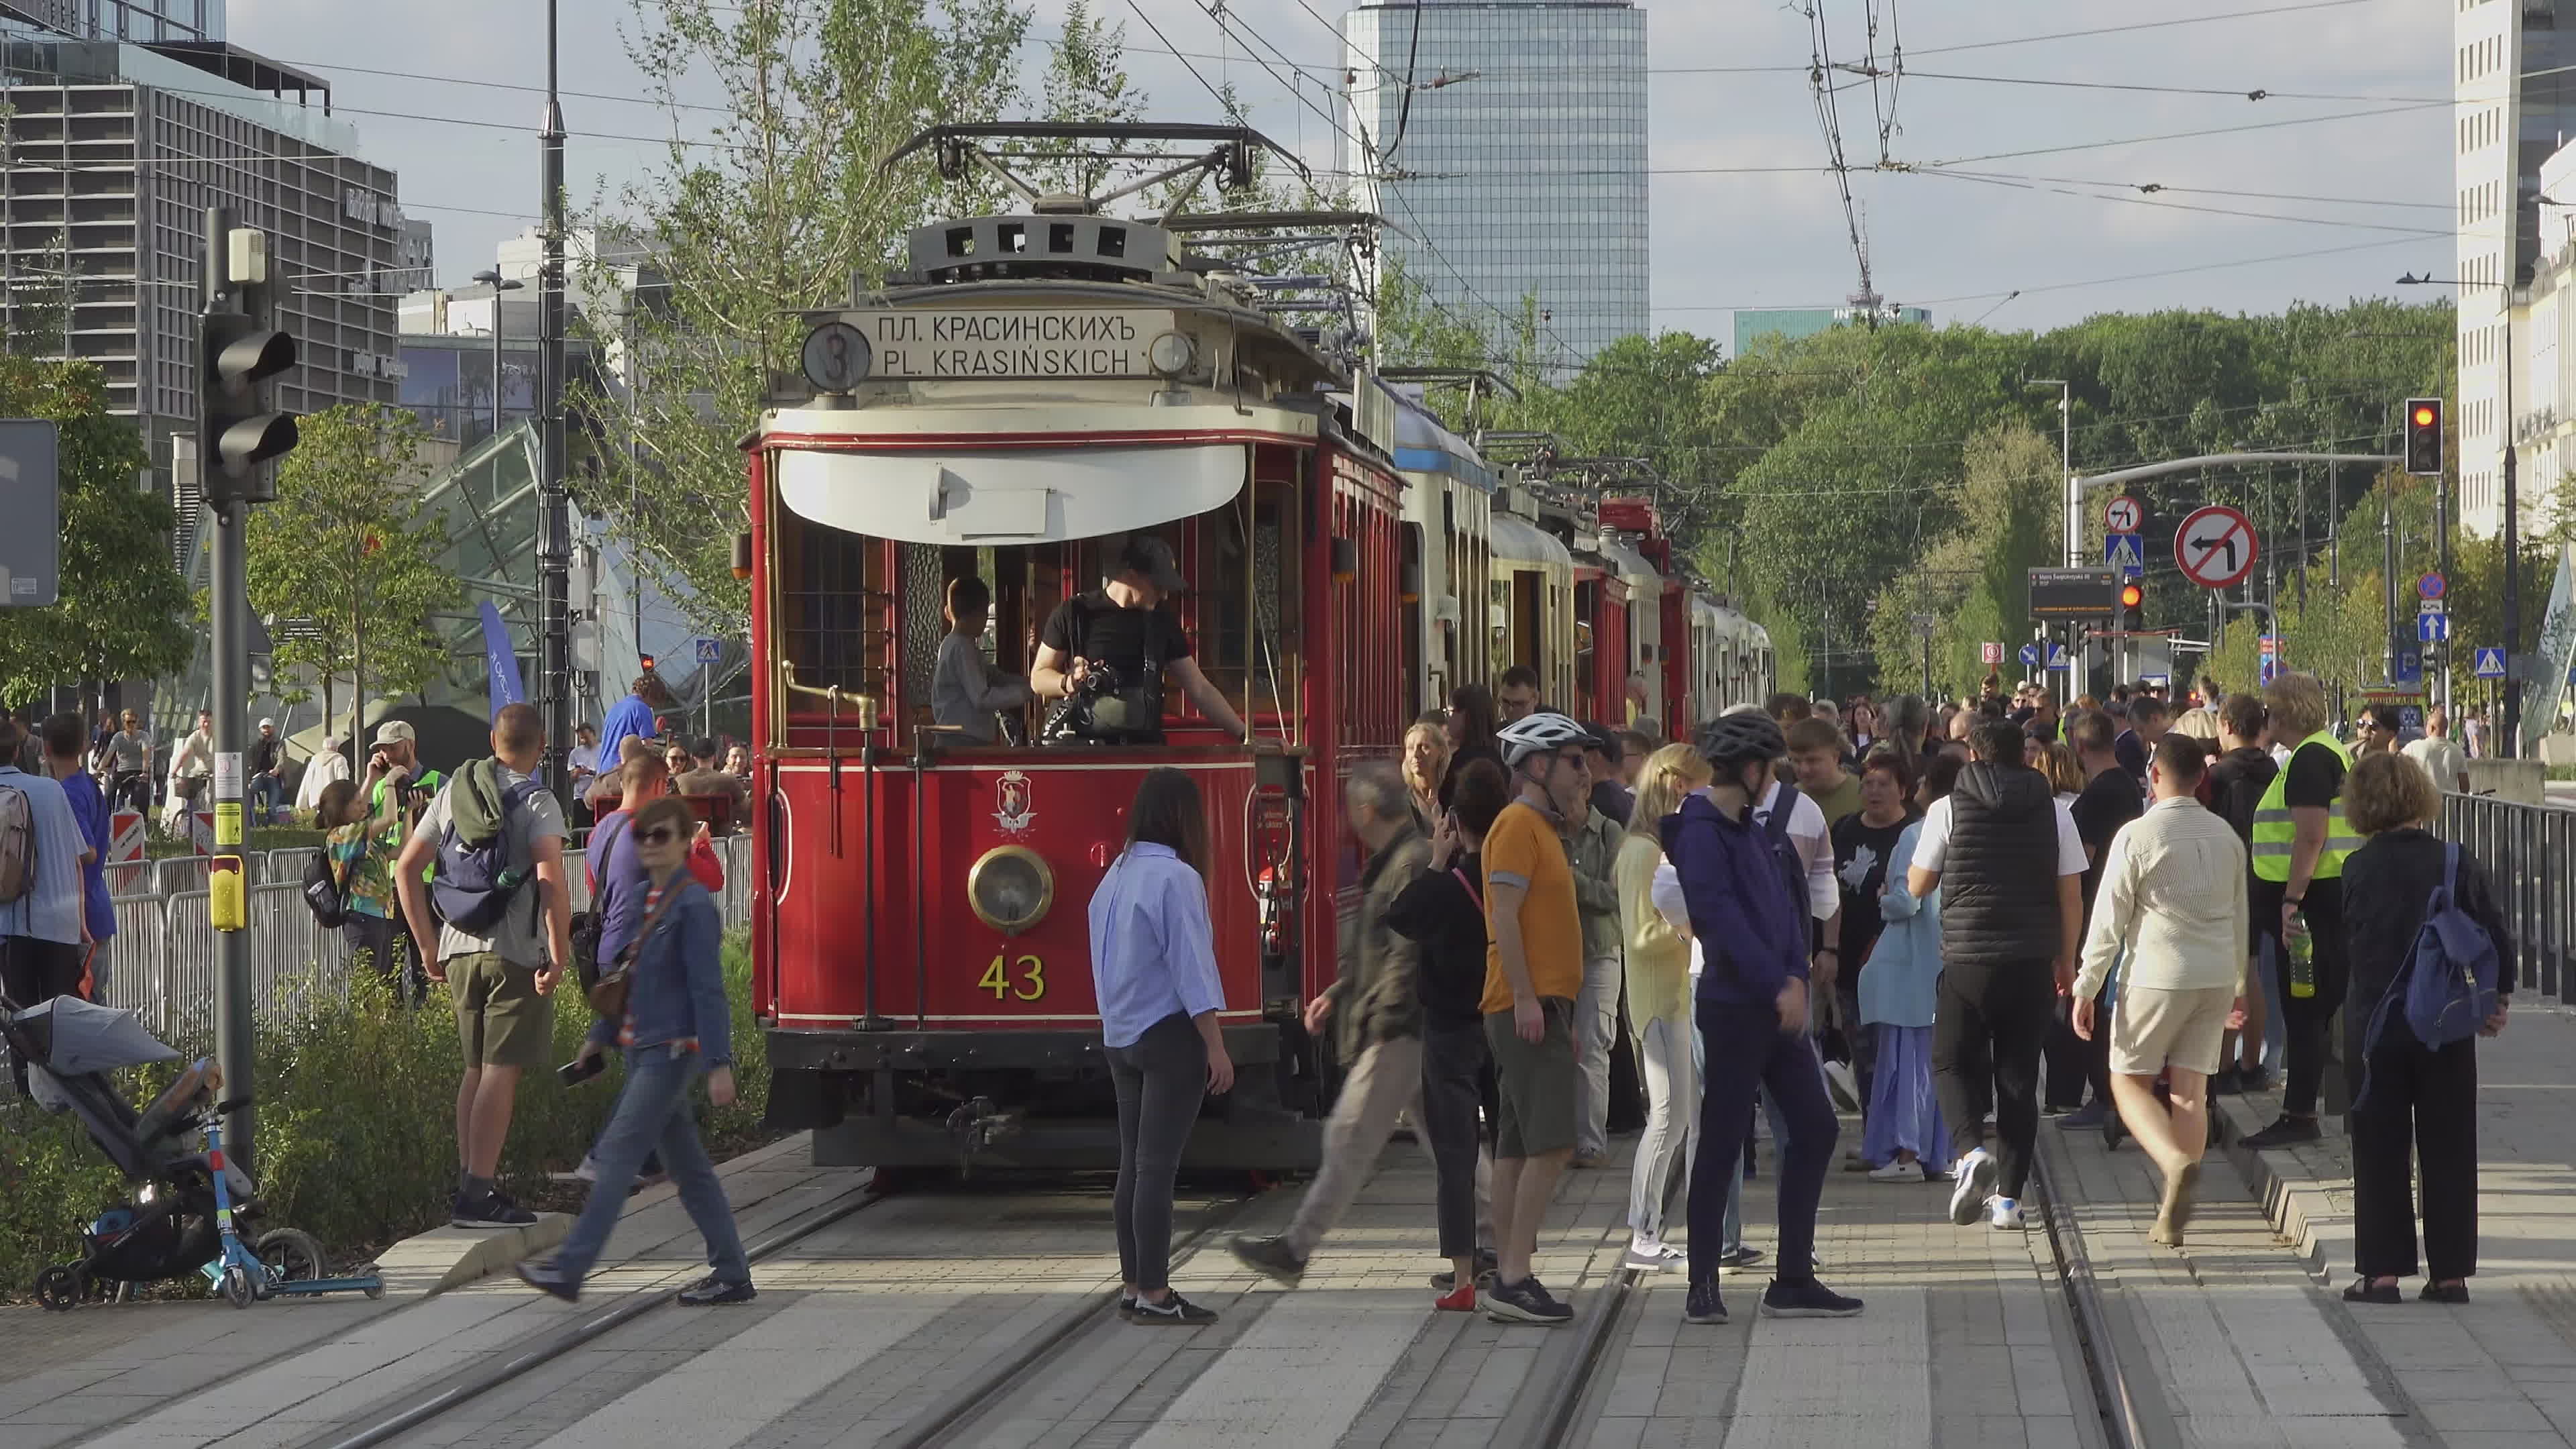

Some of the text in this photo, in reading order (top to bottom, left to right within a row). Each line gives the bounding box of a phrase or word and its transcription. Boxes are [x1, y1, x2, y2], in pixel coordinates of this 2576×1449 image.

[878, 316, 1136, 341] ПЛ. КРАСИНСКИХЪ
[883, 343, 1129, 375] PL. KRASIŃSKICH
[978, 955, 1044, 1000] 43
